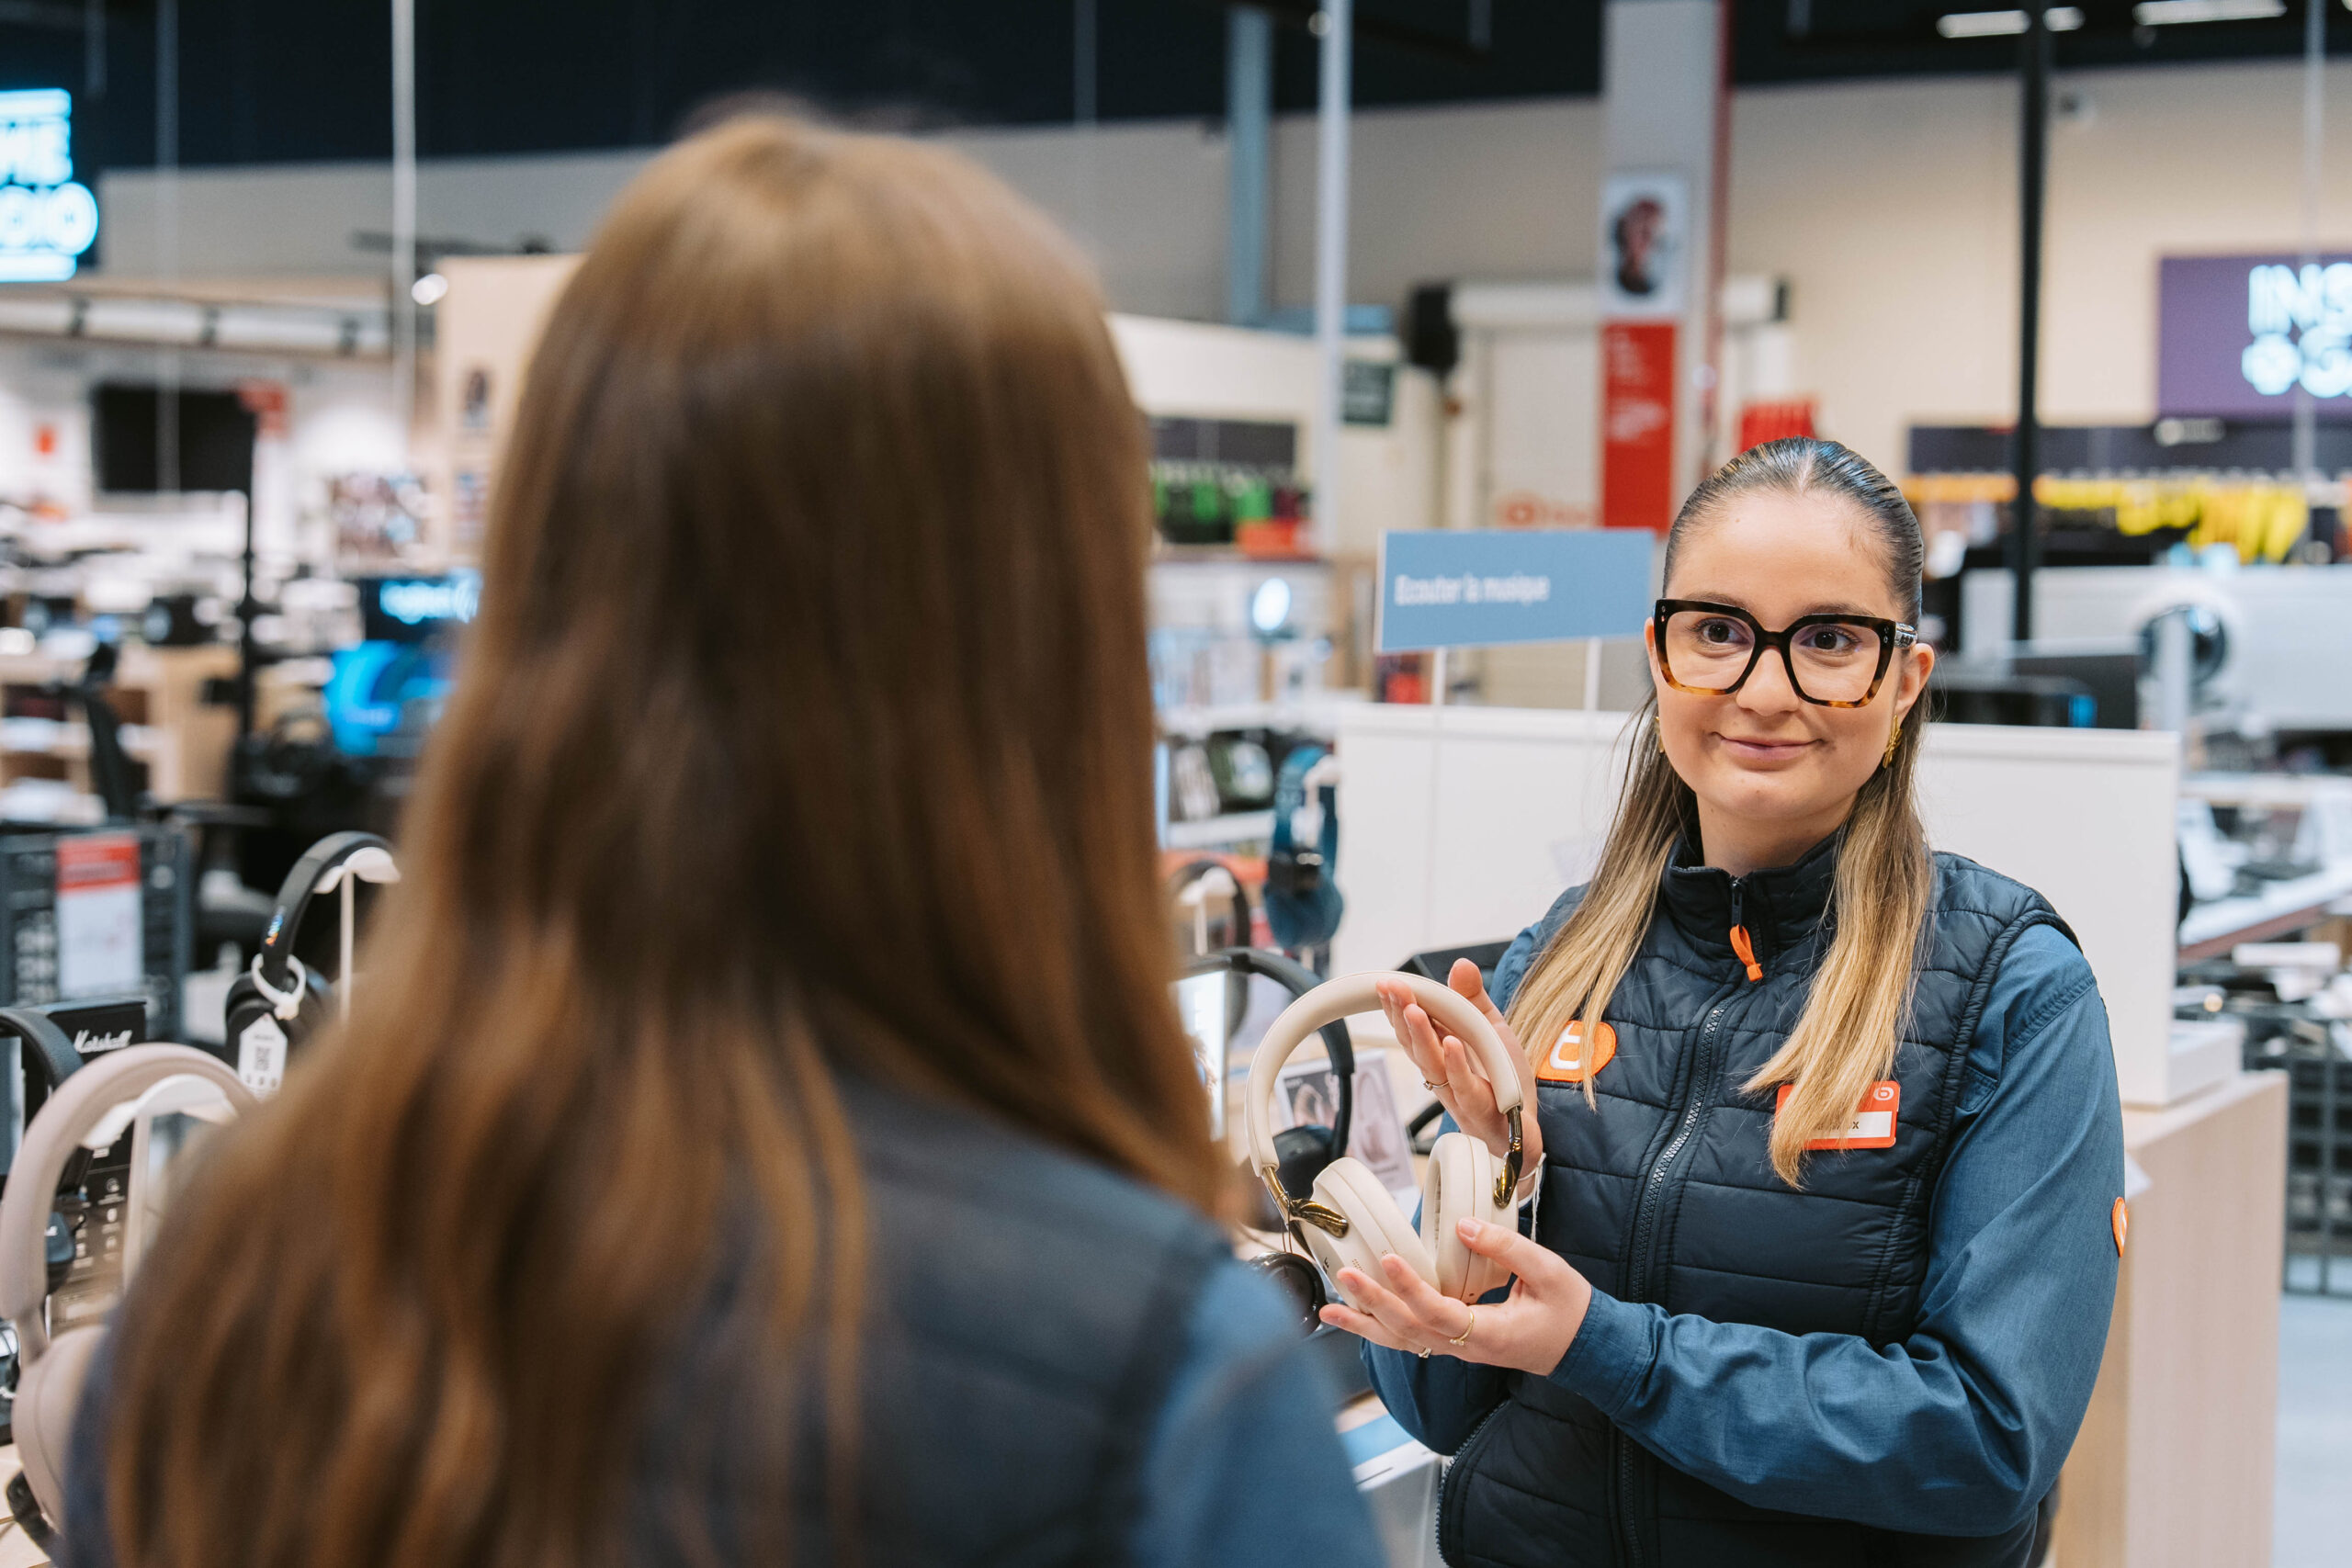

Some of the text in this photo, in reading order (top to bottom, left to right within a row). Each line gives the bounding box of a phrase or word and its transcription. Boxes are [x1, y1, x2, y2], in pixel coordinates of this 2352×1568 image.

[1464, 571, 1478, 604] la
[1483, 571, 1550, 606] musique
[74, 1030, 133, 1054] Marshall
